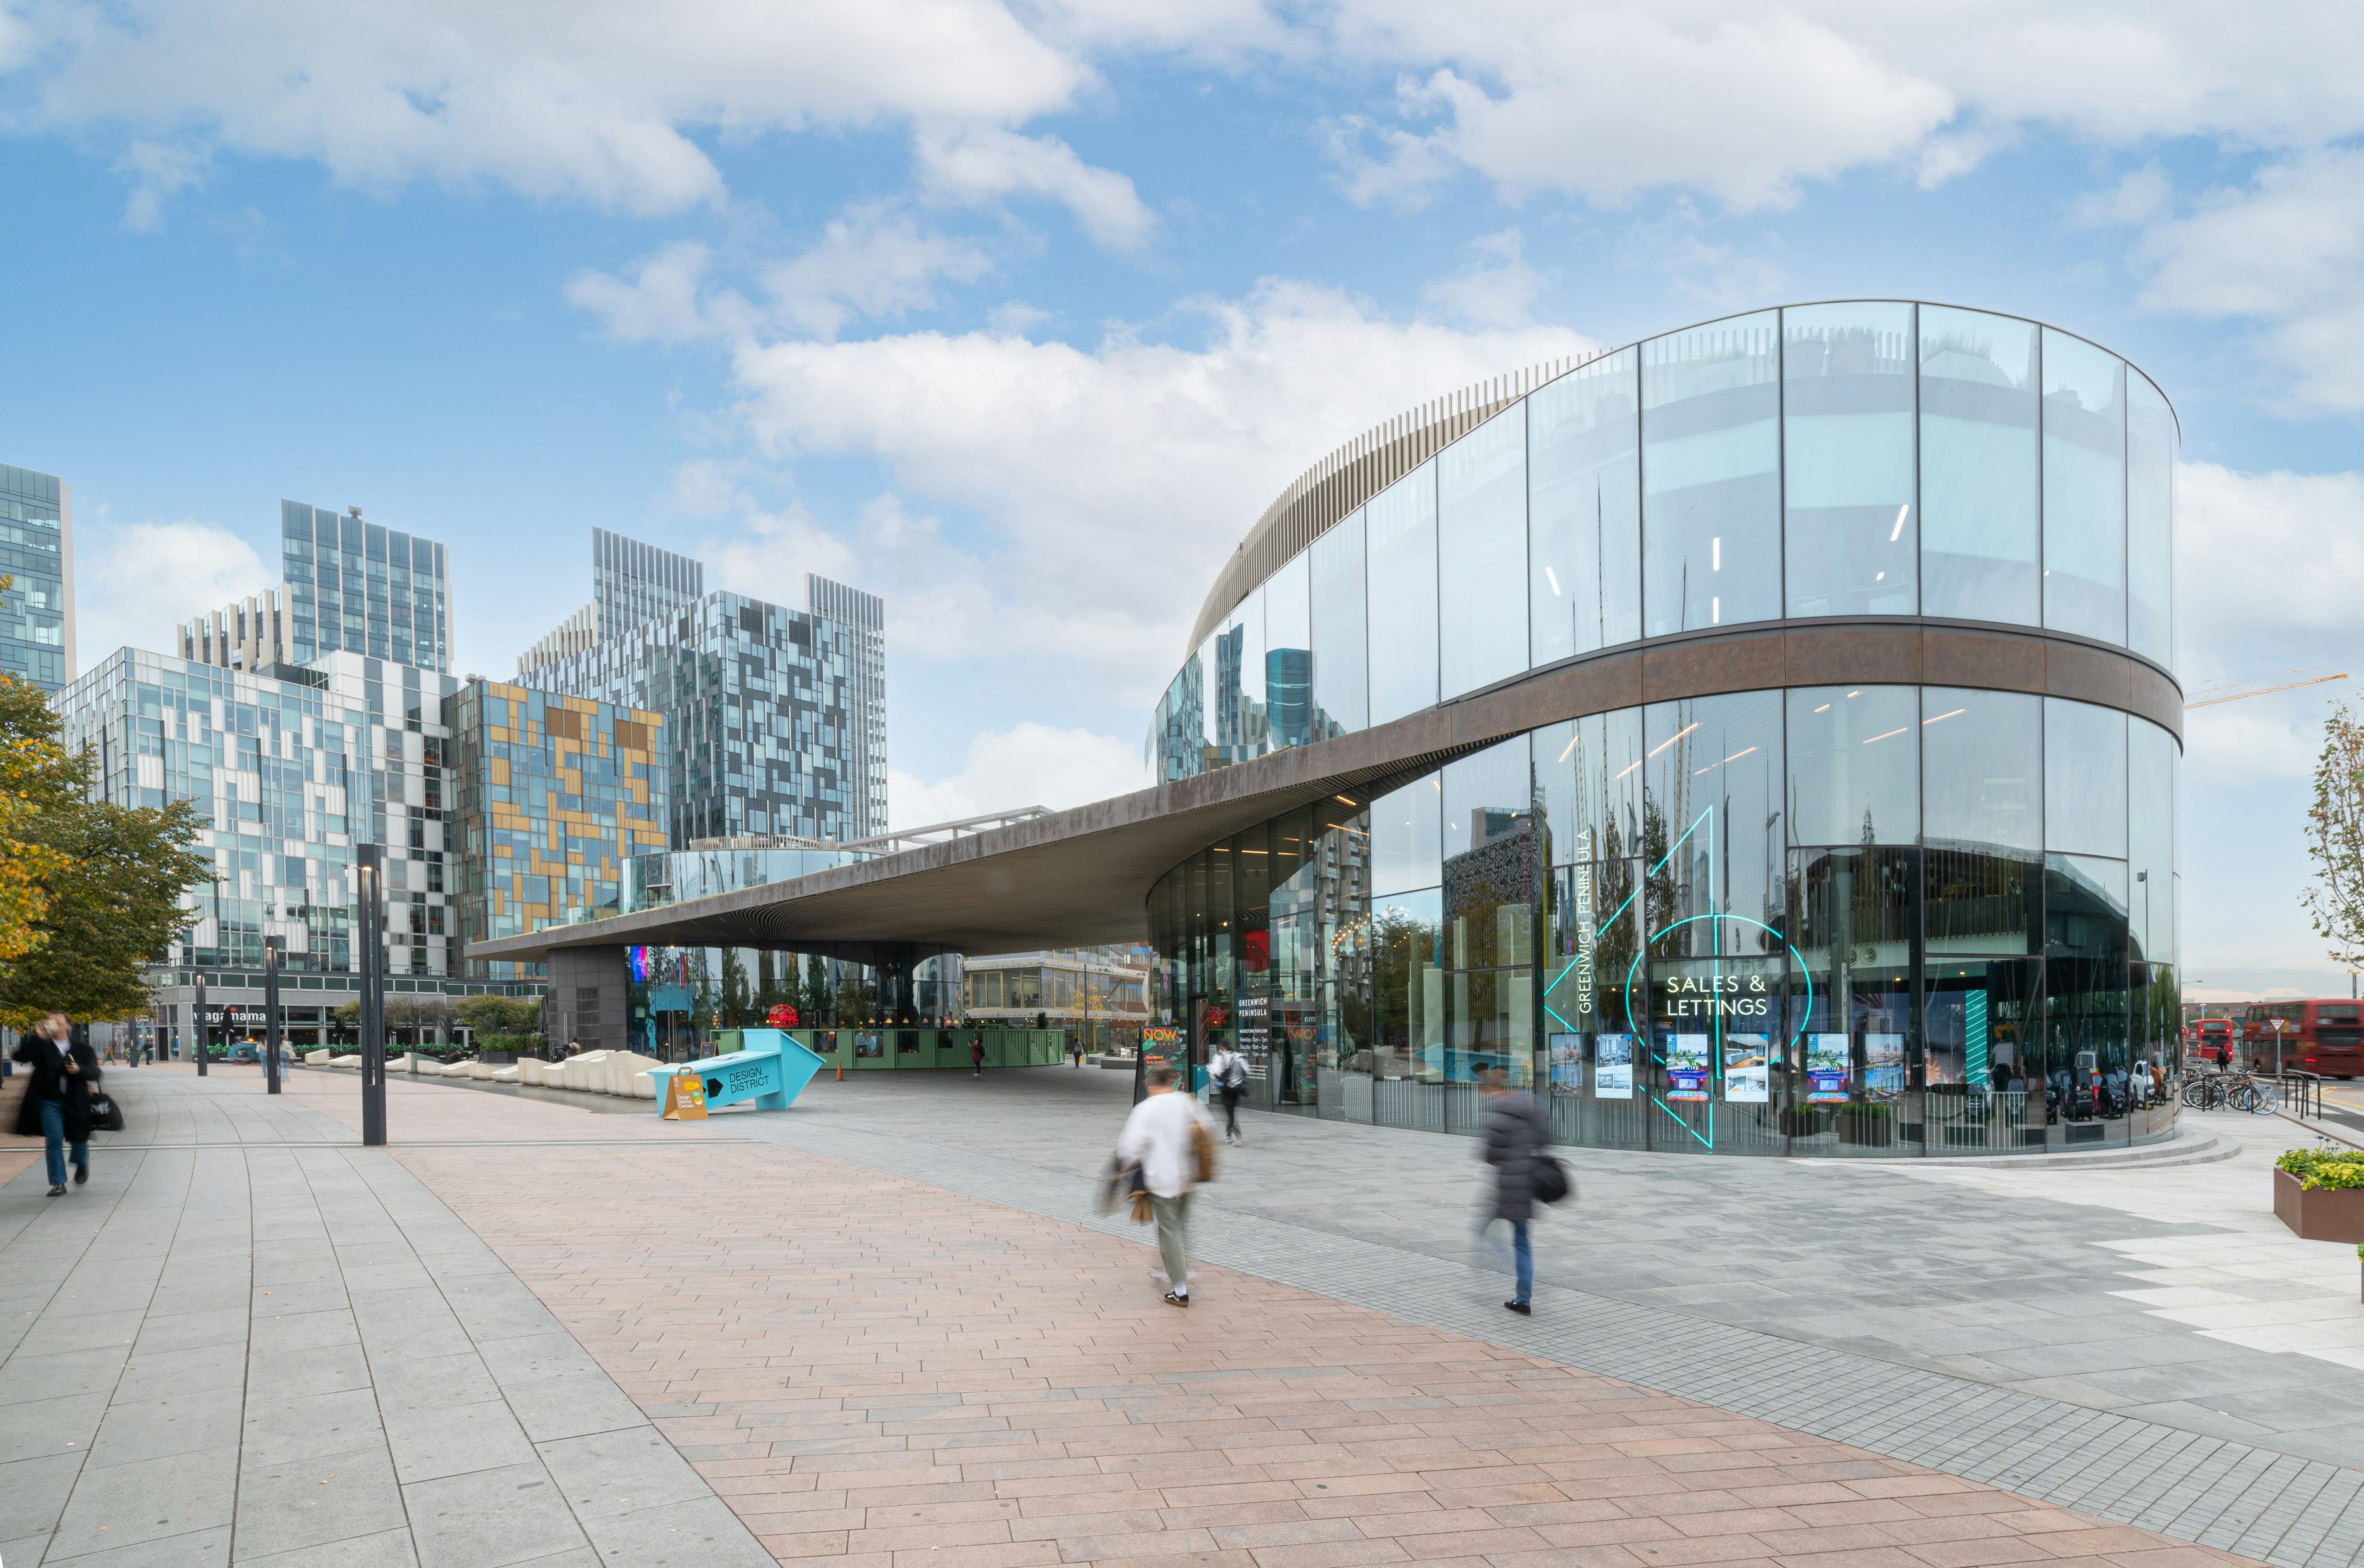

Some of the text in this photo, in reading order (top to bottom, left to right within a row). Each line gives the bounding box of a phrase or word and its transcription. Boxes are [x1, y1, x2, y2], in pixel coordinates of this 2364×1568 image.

[1578, 829, 1591, 1013] GREENWICH PENINSULA
[1667, 975, 1766, 993] SALES &
[1239, 997, 1267, 1007] GREENWICH
[1668, 998, 1767, 1016] LETTINGS
[1161, 1009, 1171, 1026] NOW
[1239, 1008, 1267, 1017] PENINSULA
[1144, 1029, 1176, 1040] NOW
[729, 1066, 762, 1083] DESIGN
[730, 1075, 769, 1093] DISTRICT
